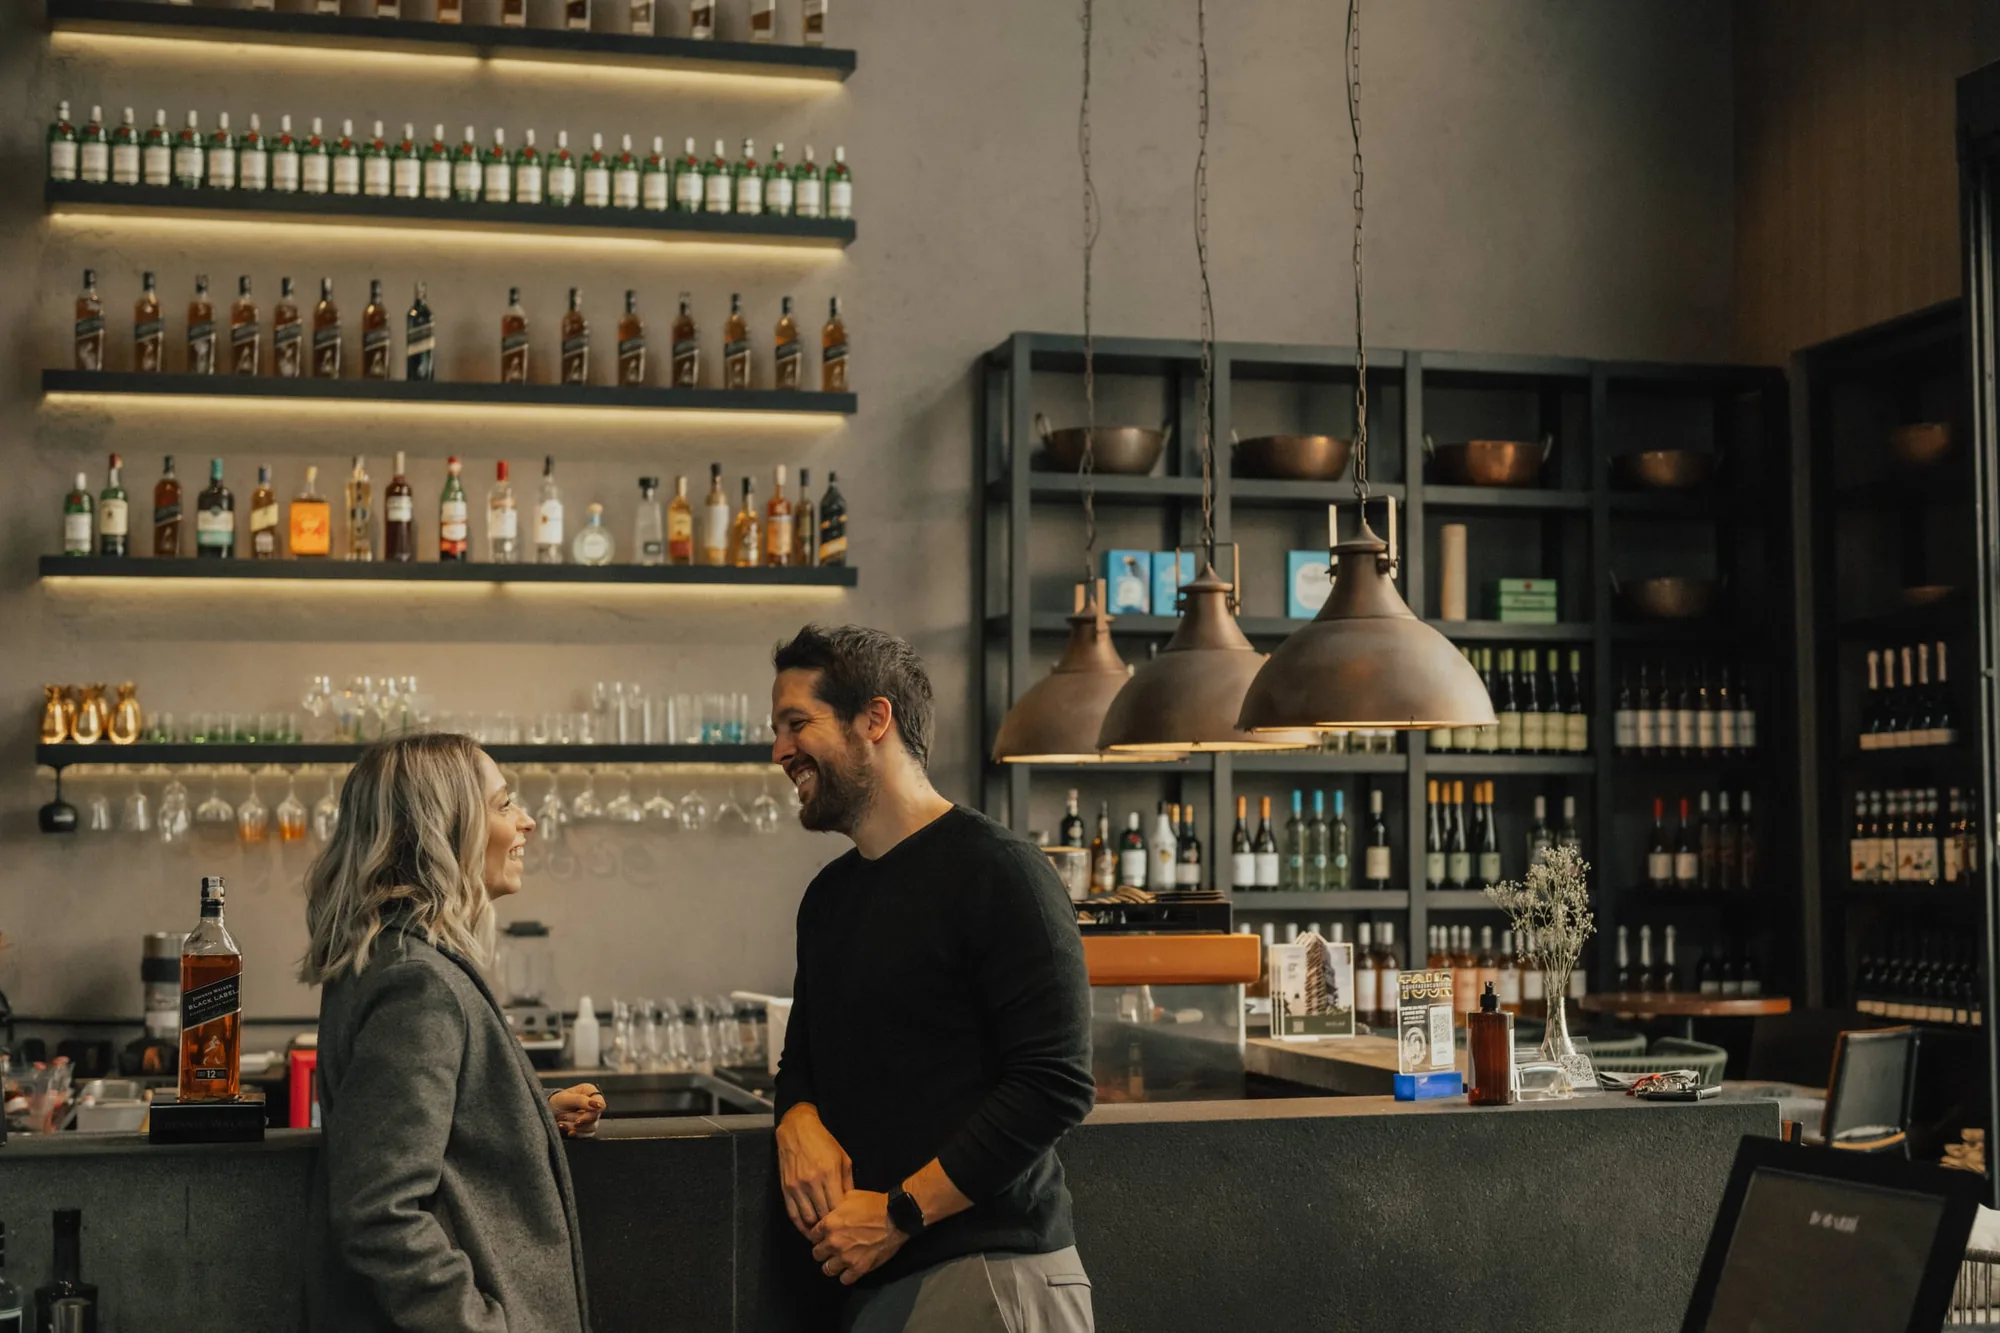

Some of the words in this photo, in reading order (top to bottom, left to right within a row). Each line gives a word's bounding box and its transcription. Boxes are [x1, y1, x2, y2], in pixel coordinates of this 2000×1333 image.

[188, 998, 213, 1010] BLACK
[213, 989, 237, 1001] LABEL
[206, 1070, 216, 1079] 12
